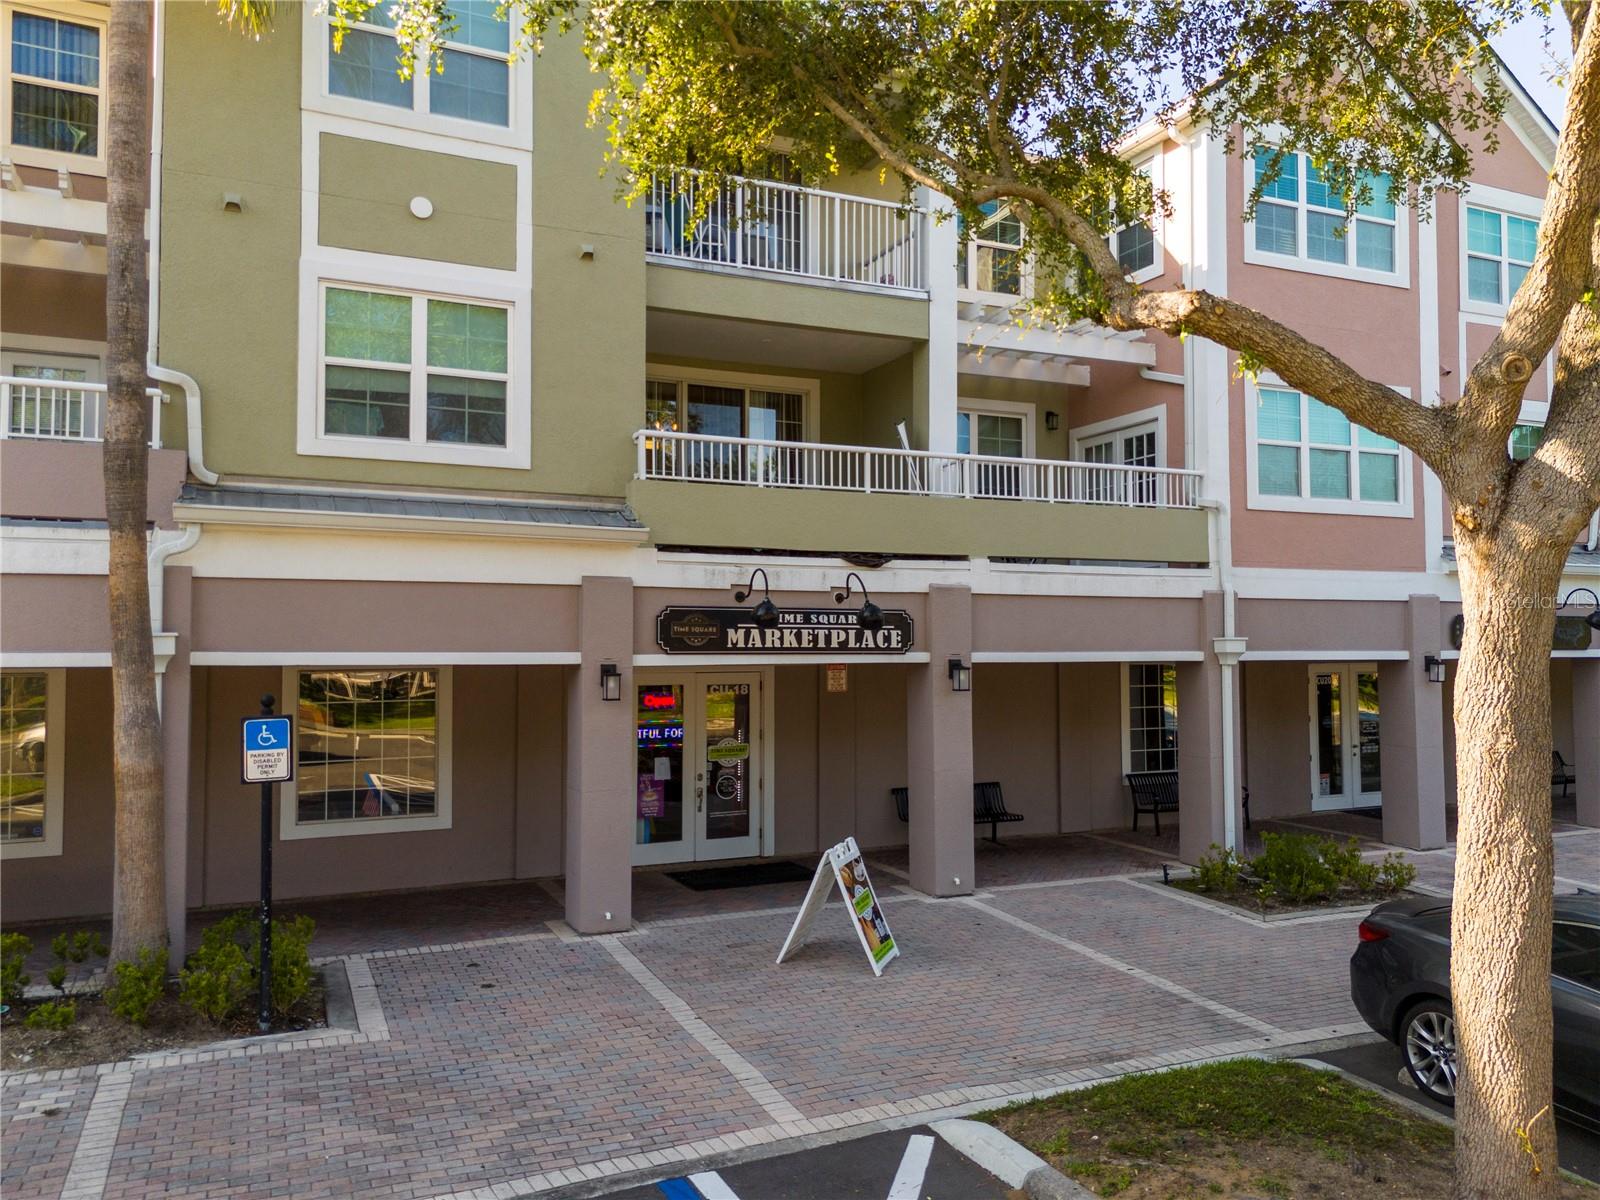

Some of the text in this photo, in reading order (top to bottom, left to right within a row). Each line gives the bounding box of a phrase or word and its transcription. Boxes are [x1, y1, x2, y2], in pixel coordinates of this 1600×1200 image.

[778, 613, 857, 625] IME SQUAR
[673, 625, 717, 633] TIME SQUARE
[726, 628, 902, 649] MARKETPLACE
